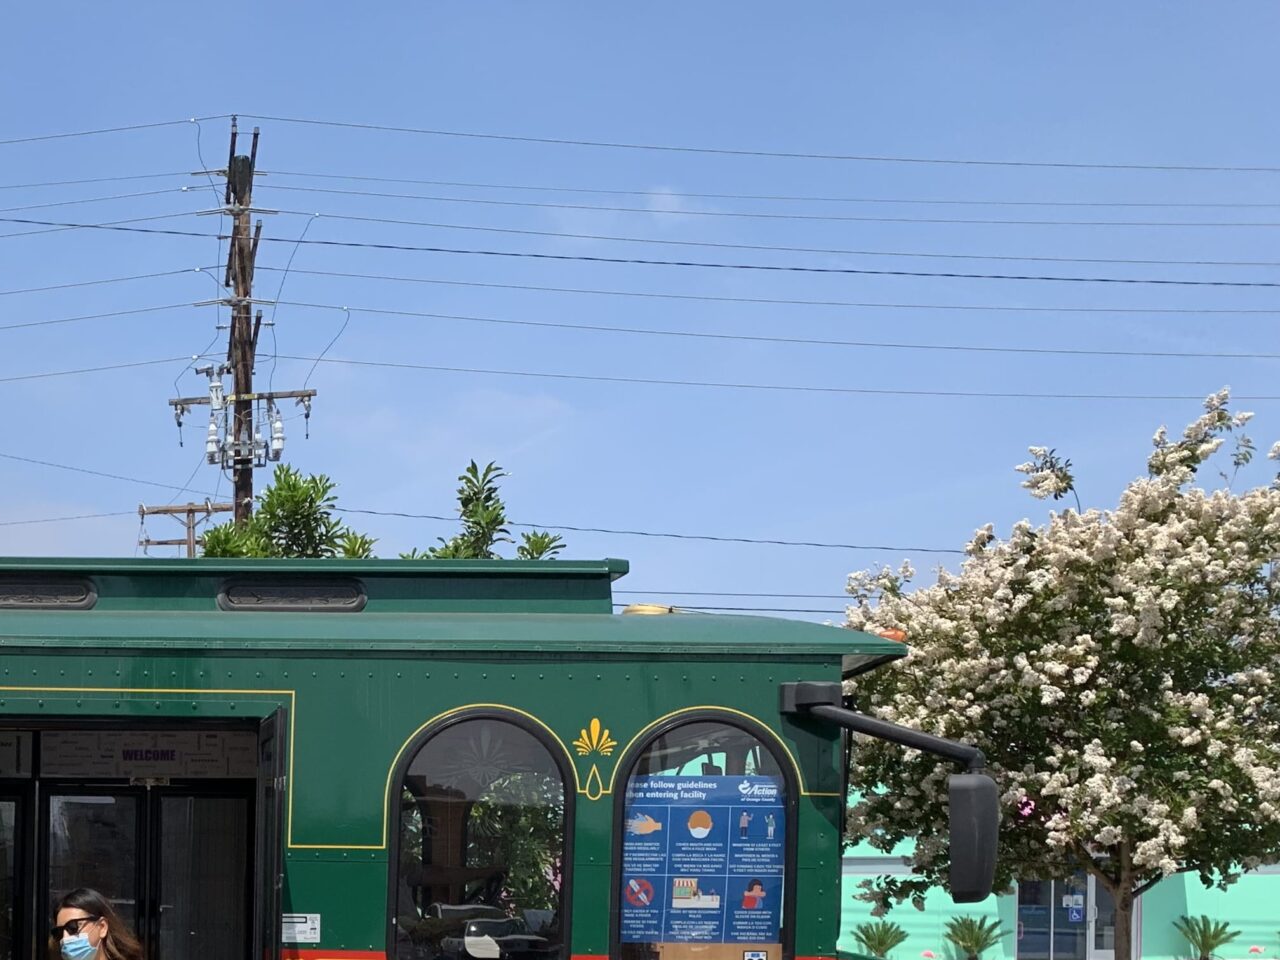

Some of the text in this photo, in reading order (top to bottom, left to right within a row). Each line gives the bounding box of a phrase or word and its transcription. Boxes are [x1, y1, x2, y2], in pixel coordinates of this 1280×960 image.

[122, 749, 176, 761] WELCOME
[628, 780, 718, 791] lease follow guidelines
[646, 790, 679, 800] entering
[680, 790, 707, 800] facility
